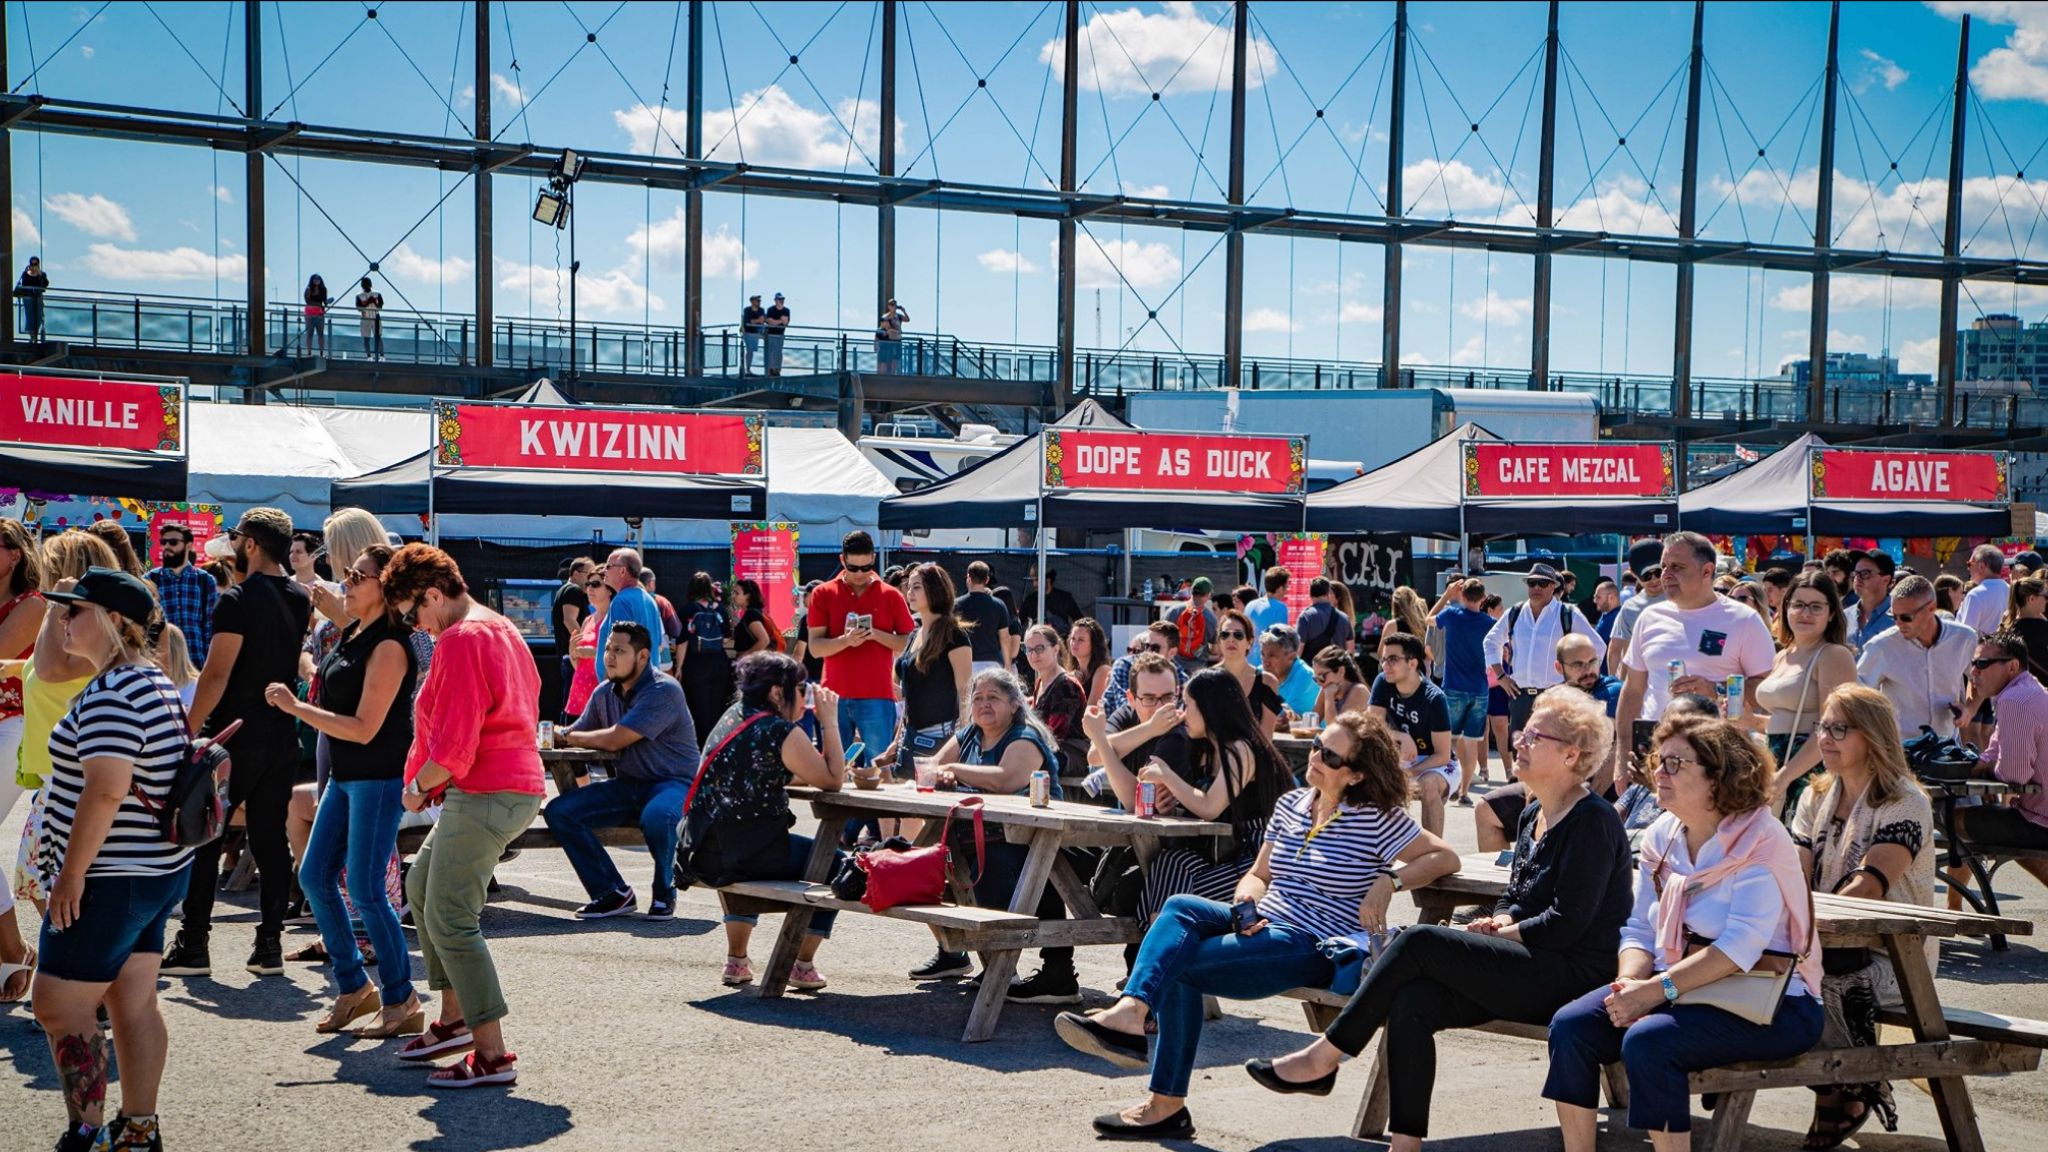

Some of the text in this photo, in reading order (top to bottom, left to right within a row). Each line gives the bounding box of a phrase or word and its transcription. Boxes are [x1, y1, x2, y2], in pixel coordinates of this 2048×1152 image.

[20, 395, 139, 429] VANILLE
[520, 419, 687, 461] KWIZINN
[1077, 445, 1271, 479] DOPE AS DUCK
[1499, 457, 1641, 483] CAFE MEZCAL
[1871, 460, 1950, 492] AGAVE
